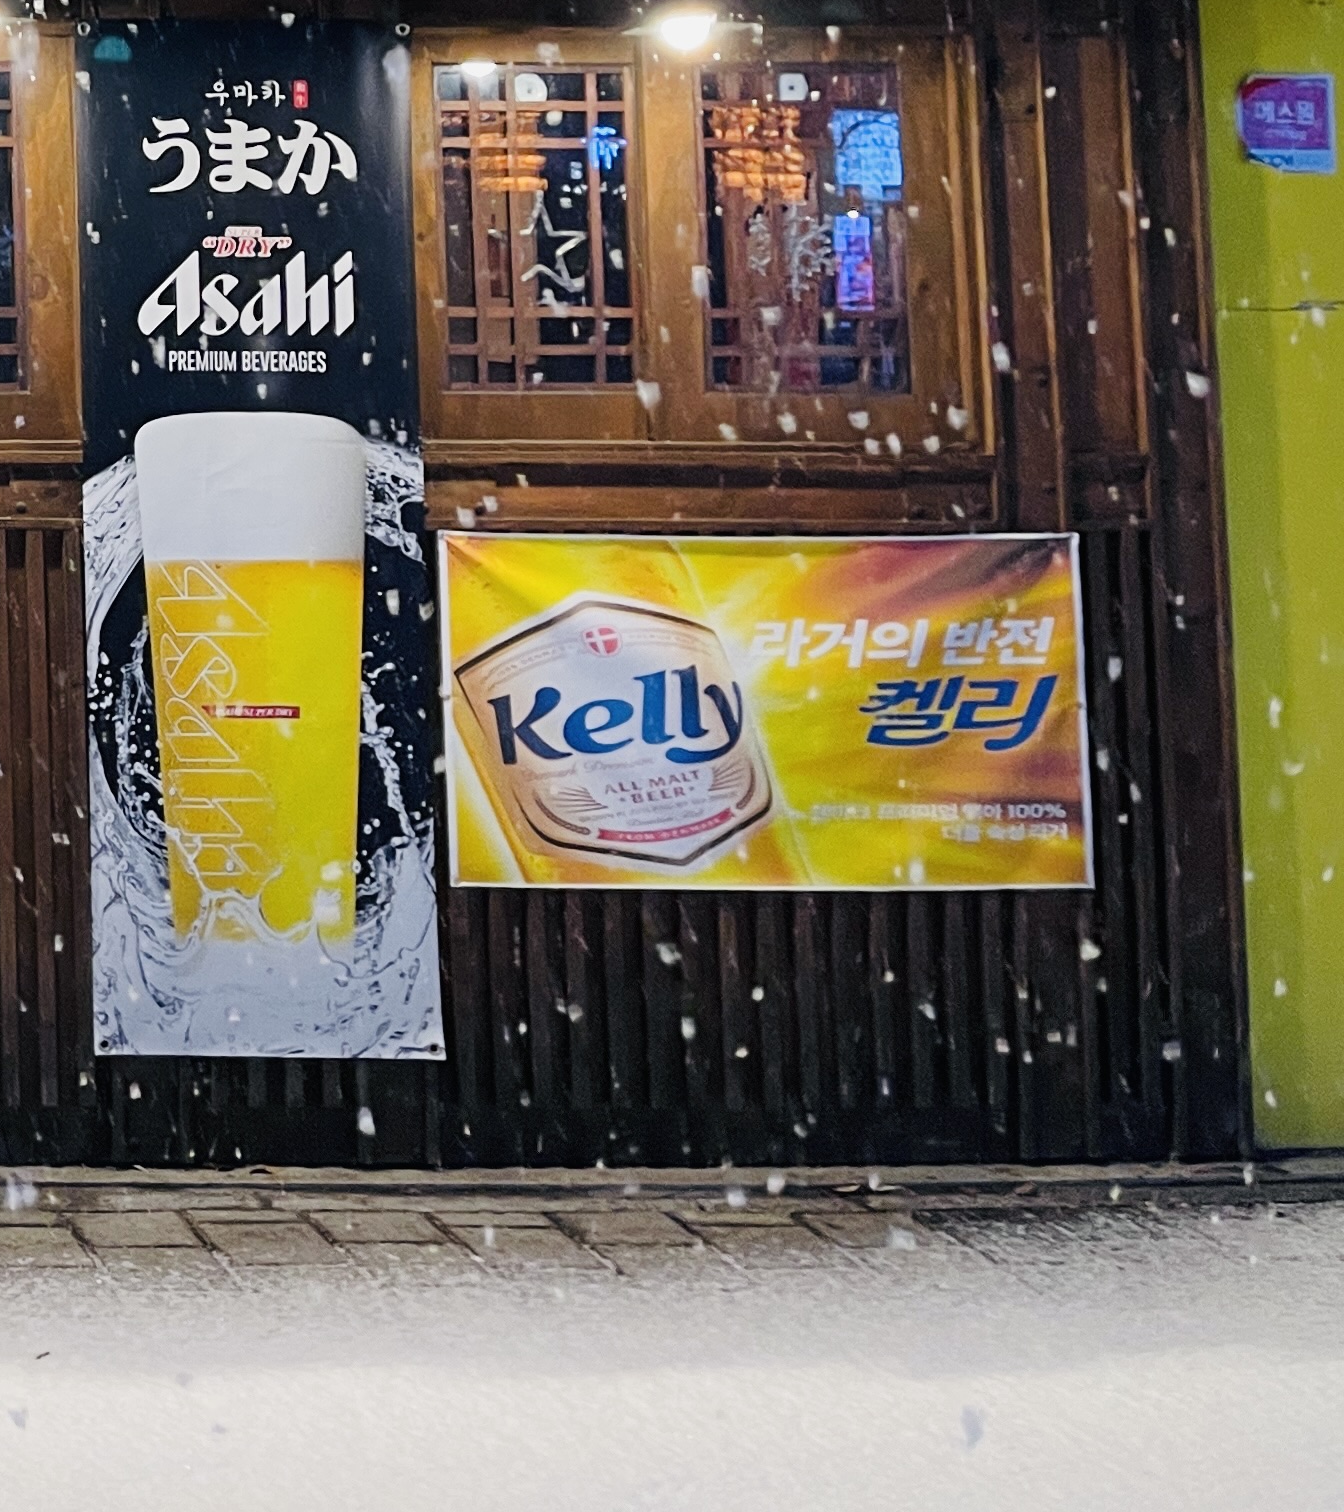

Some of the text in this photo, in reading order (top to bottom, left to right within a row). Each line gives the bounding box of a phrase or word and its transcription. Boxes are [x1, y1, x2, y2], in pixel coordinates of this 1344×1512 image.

[205, 80, 286, 108] 우마카
[142, 115, 358, 195] うまか
[137, 250, 355, 337] Asahi
[168, 350, 327, 374] PREMIUM BEVERAGES
[749, 618, 929, 669] 라거의
[942, 616, 1055, 666] 반전
[487, 664, 743, 765] Kelly
[858, 674, 1059, 752] 켈리
[604, 770, 700, 798] ALL MALT
[631, 787, 686, 804] BEER
[1006, 802, 1067, 819] 100%
